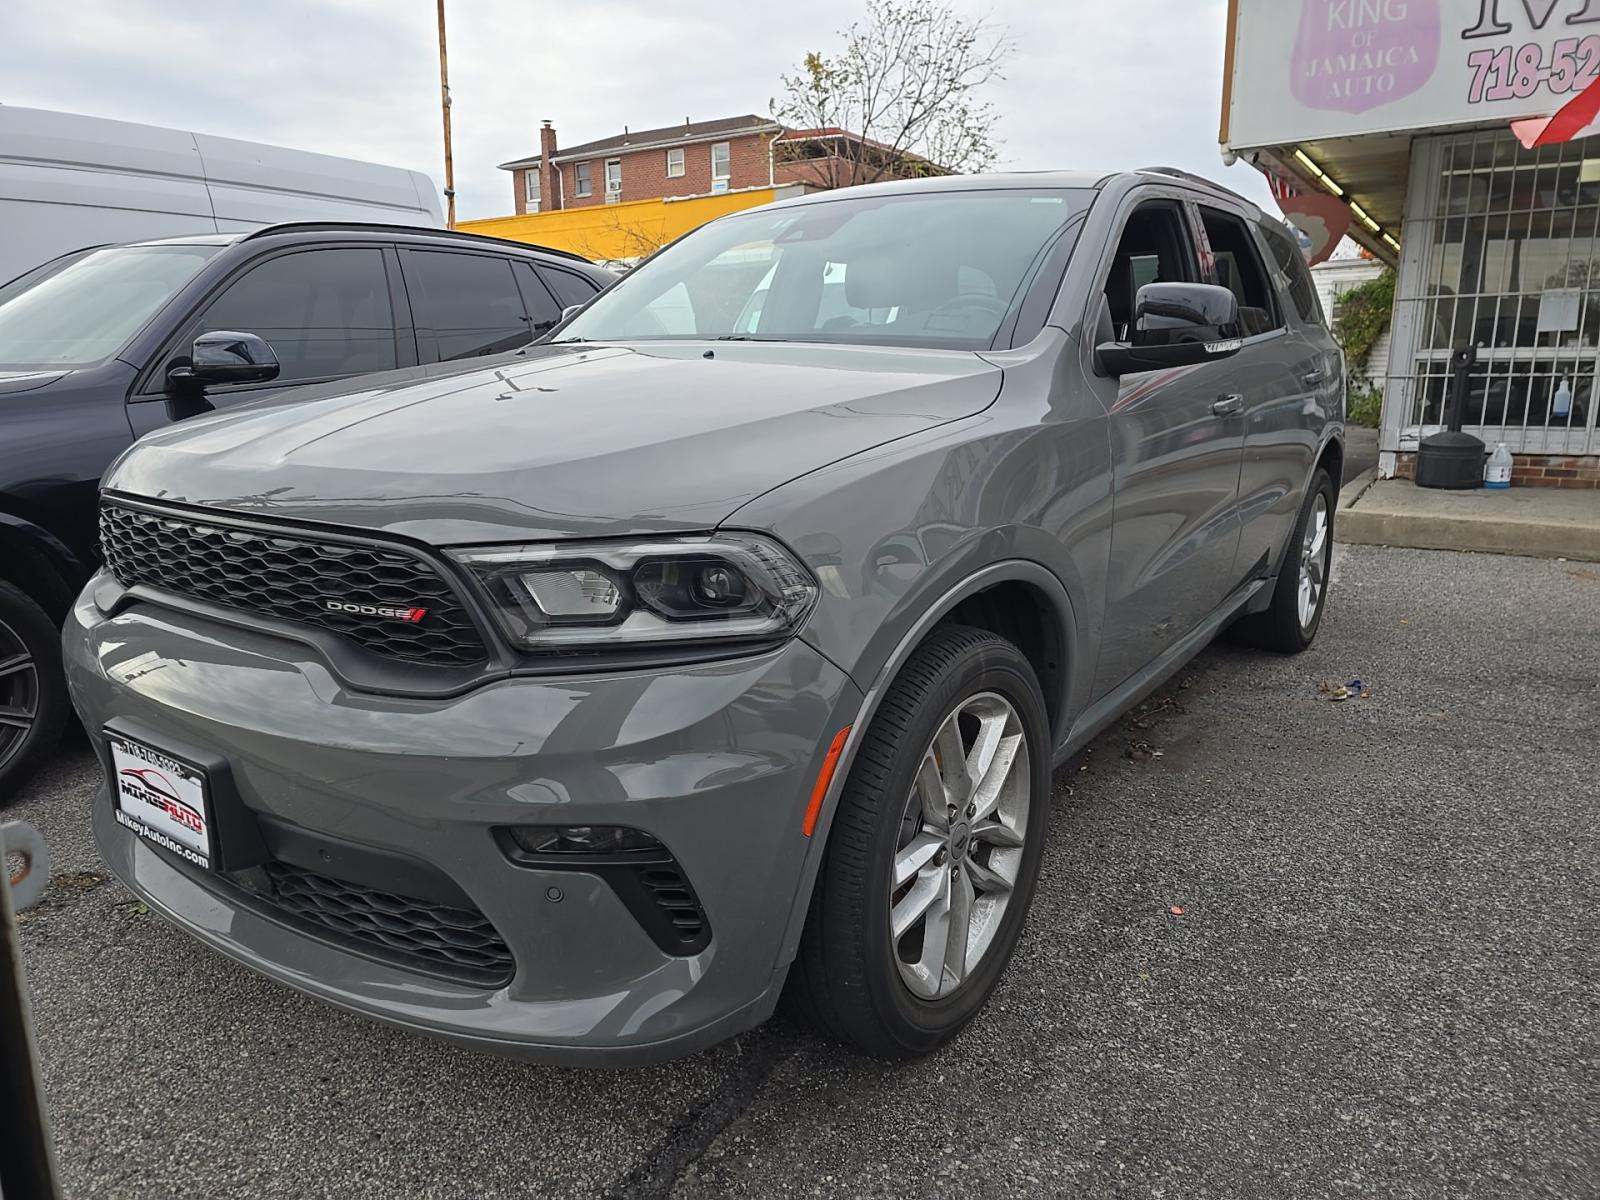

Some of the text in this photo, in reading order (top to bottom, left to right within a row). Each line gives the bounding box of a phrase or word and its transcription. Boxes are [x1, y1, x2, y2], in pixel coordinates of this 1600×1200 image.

[1327, 0, 1408, 31] KING
[1352, 31, 1377, 48] OF
[1305, 45, 1419, 77] JAMAICA
[1327, 73, 1395, 100] AUTO
[327, 602, 411, 618] DODGE
[115, 809, 209, 869] MikeyAutoInc.com
